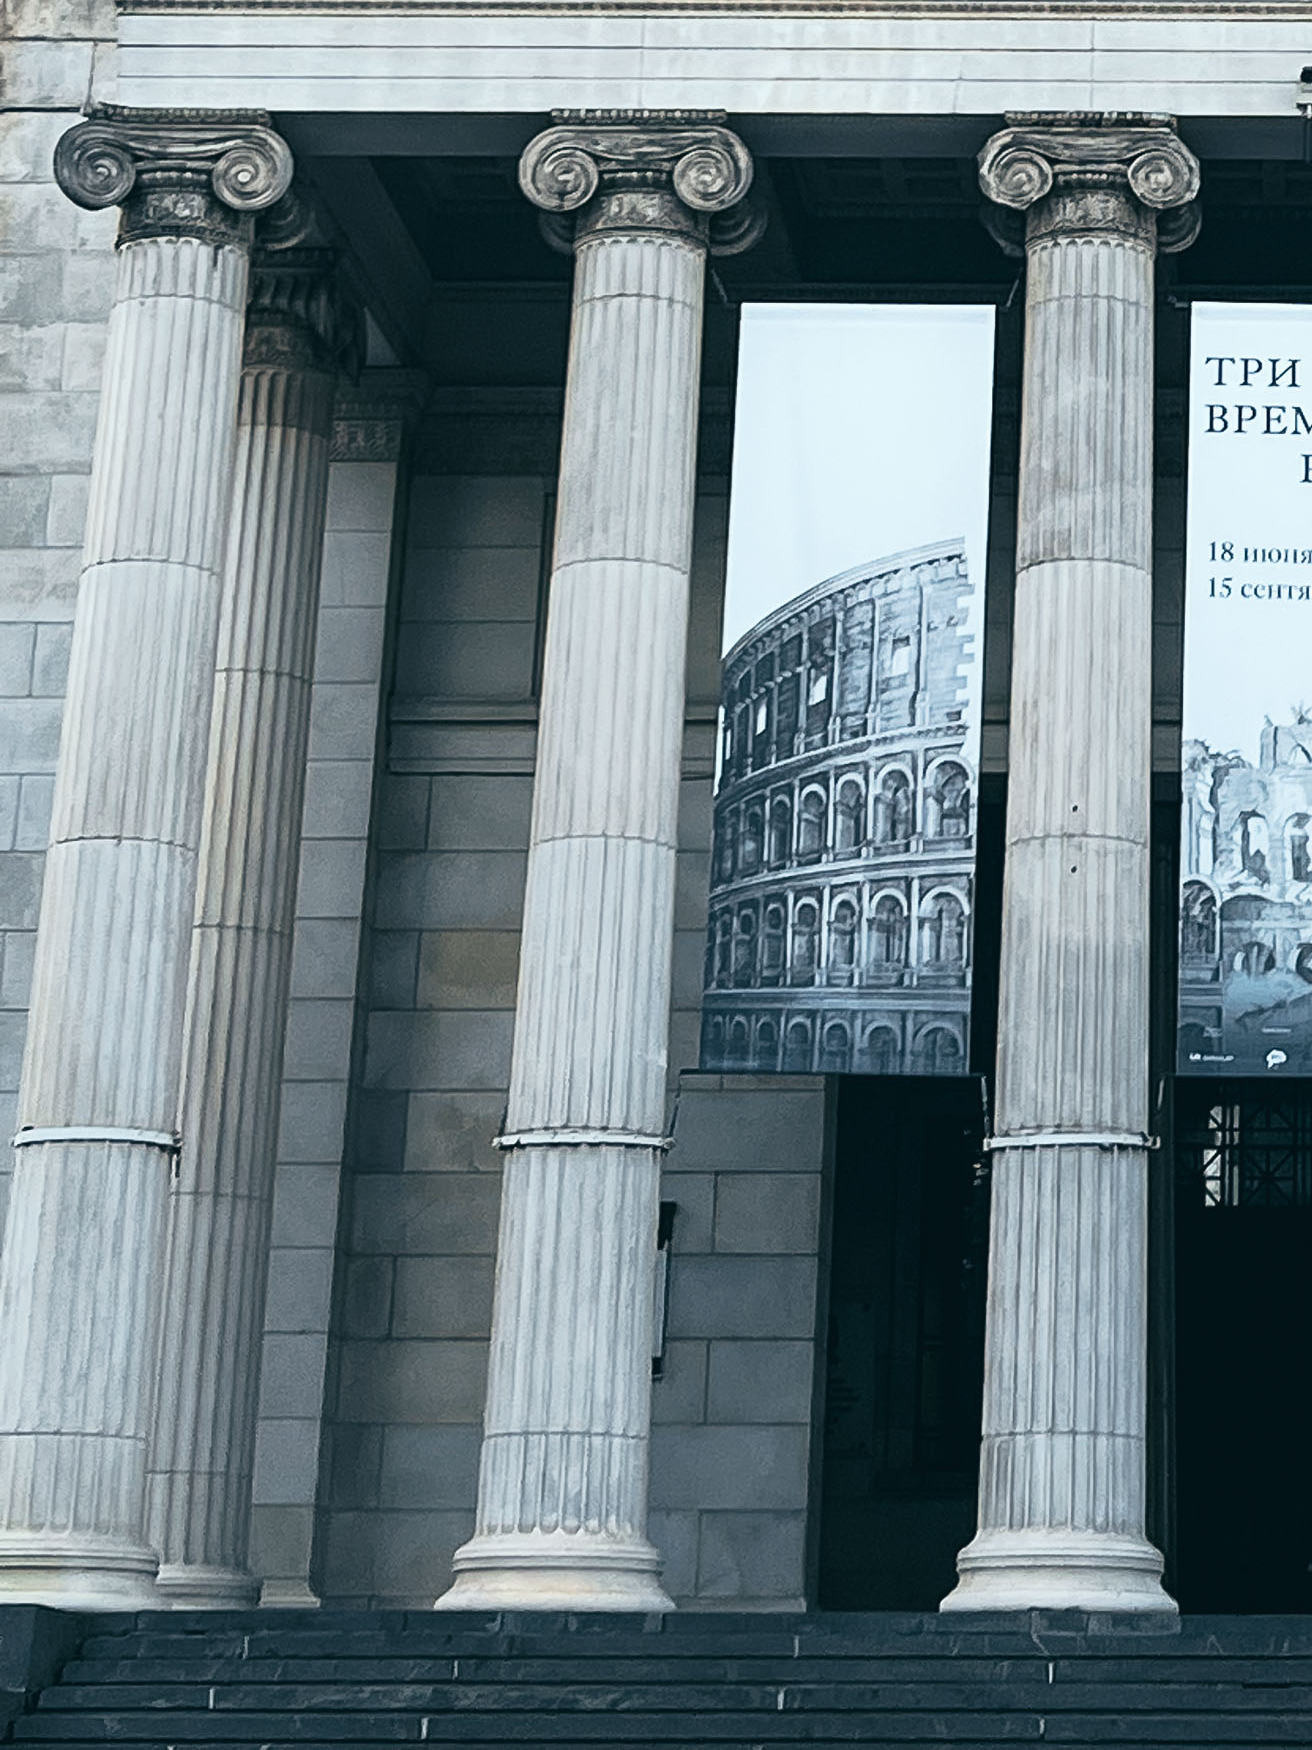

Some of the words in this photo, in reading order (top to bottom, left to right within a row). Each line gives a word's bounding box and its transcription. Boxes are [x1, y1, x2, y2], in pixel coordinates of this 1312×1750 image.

[1204, 356, 1301, 388] ТРИ
[1208, 541, 1235, 562] 18
[1243, 547, 1312, 564] июня
[1208, 577, 1233, 598] 15
